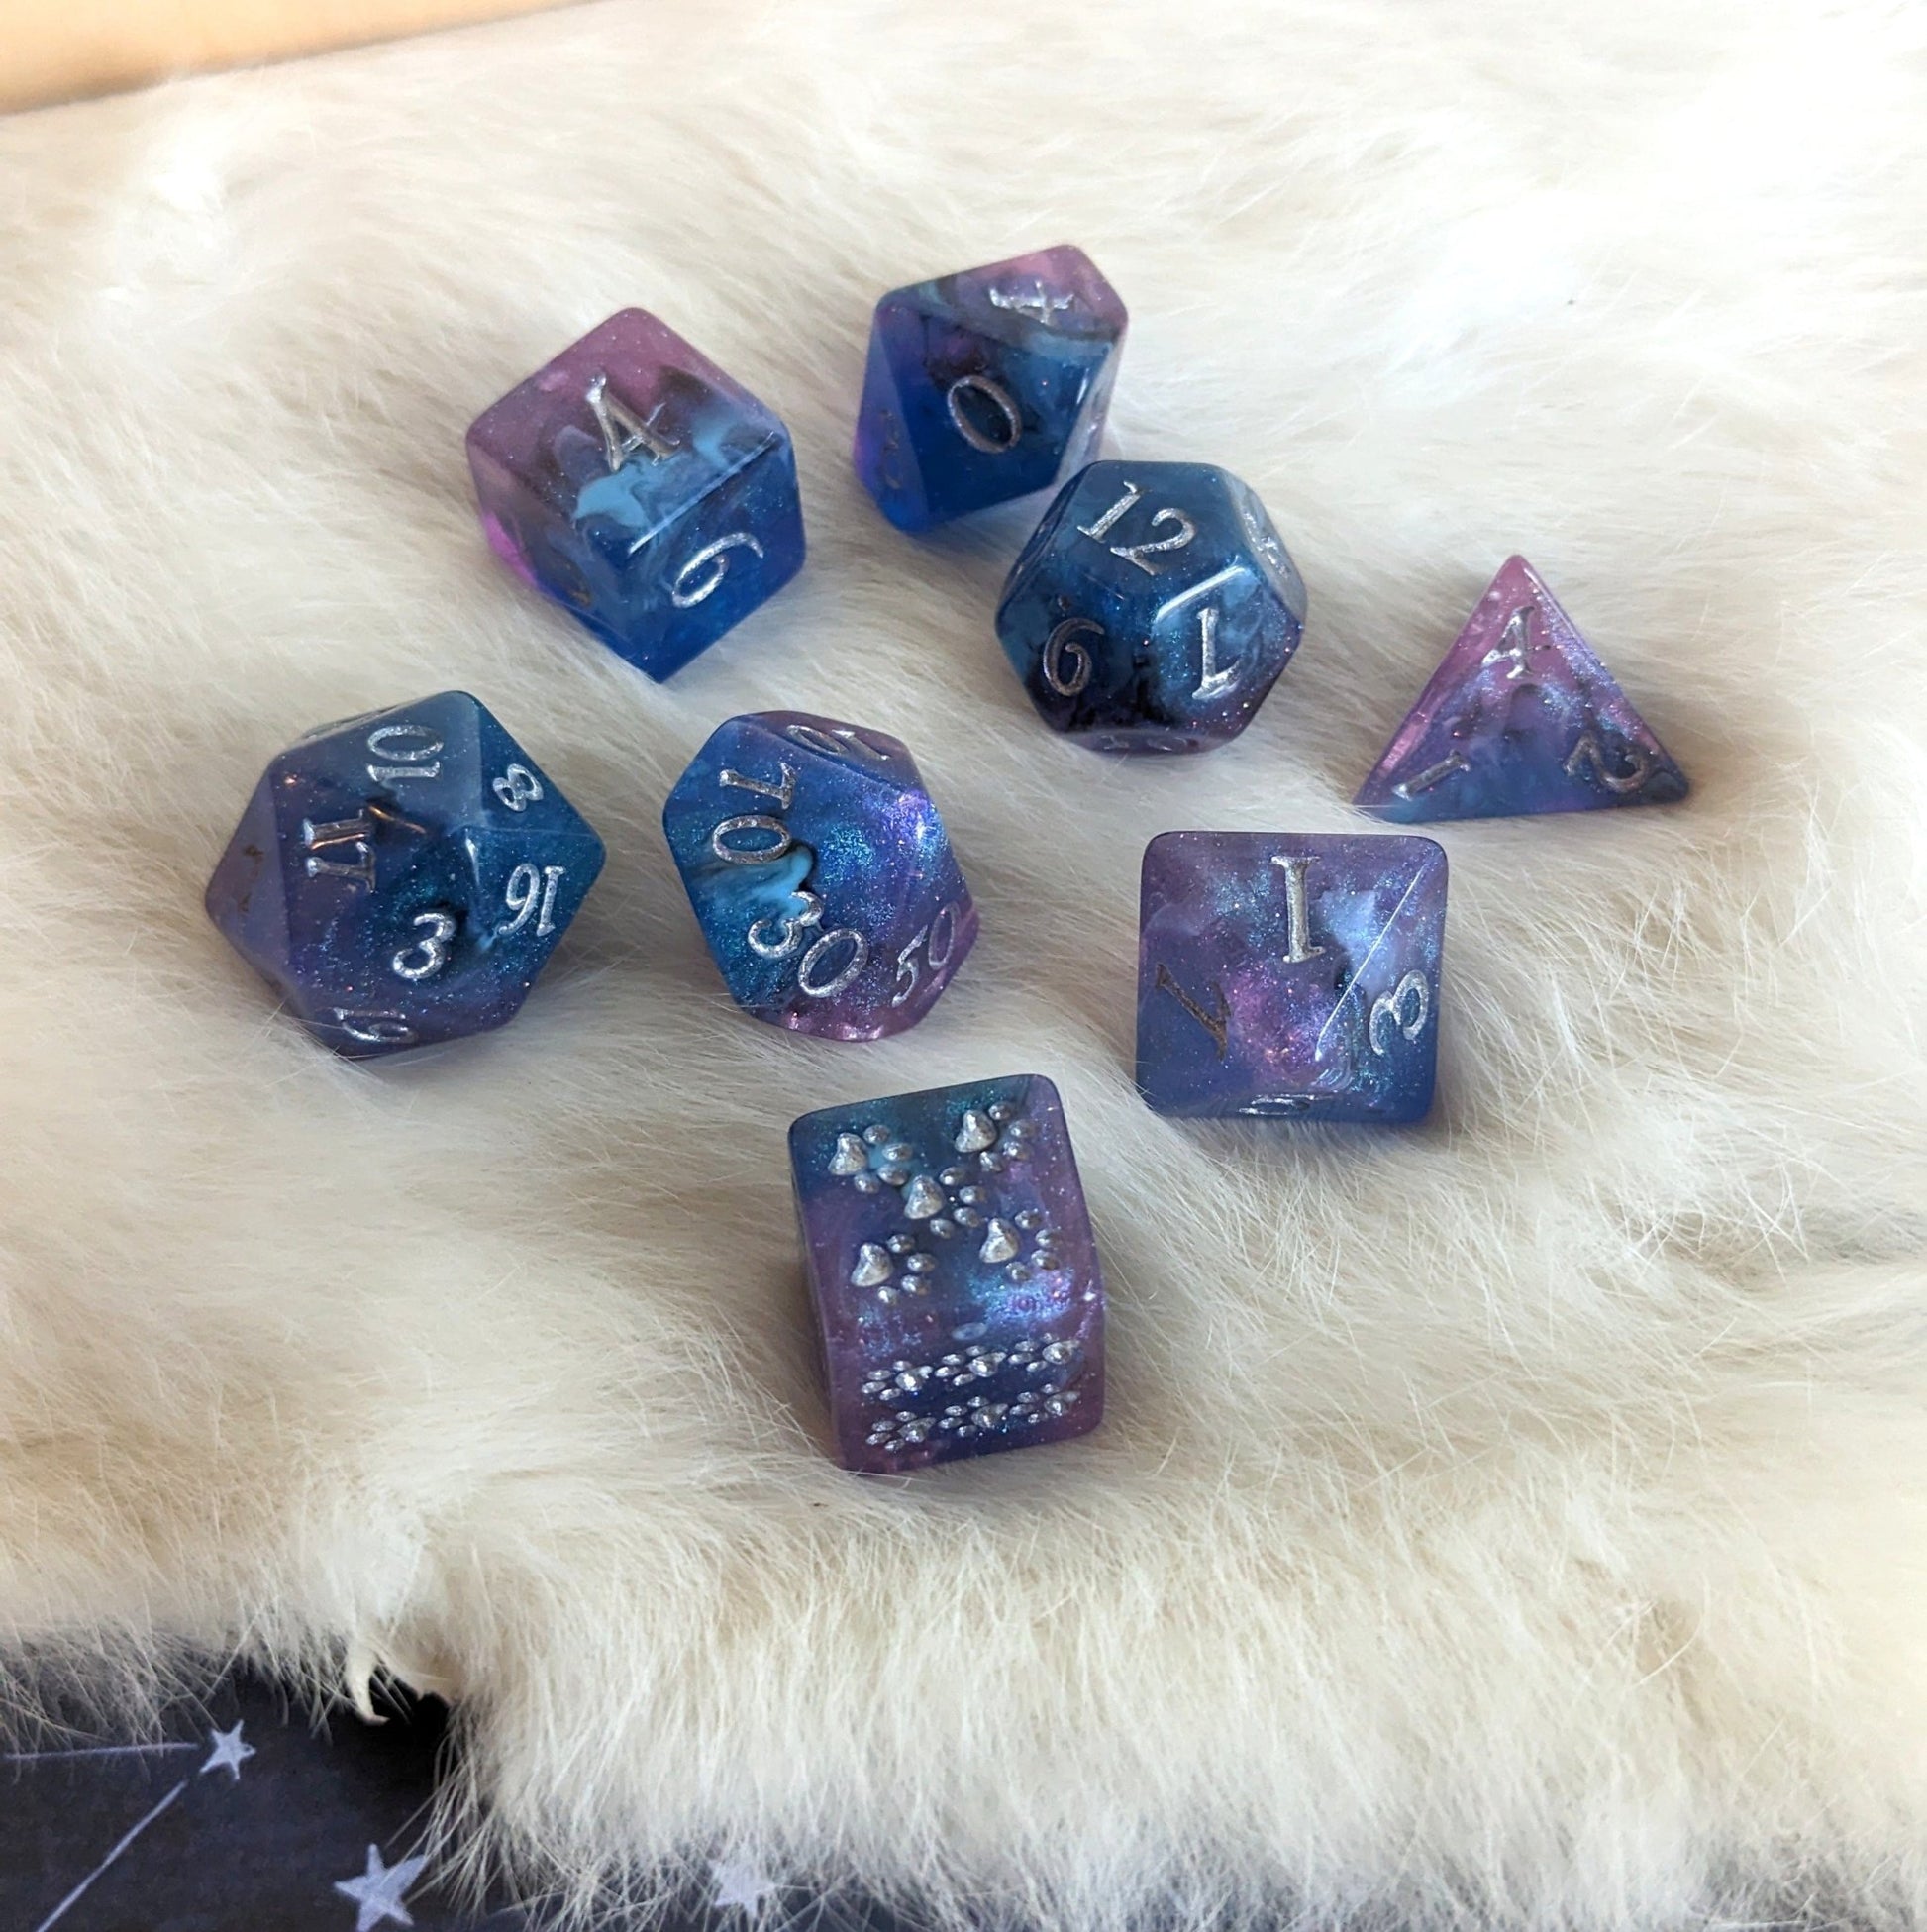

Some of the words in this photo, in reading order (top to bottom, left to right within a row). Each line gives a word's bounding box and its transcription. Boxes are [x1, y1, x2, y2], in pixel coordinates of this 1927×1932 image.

[947, 374, 1022, 455] 0
[1076, 479, 1198, 576] 12
[365, 724, 446, 790] 10
[492, 763, 545, 813] 8
[1390, 749, 1472, 802] 1
[1562, 729, 1651, 793] 2
[712, 762, 797, 864] 70
[392, 911, 456, 980] 3
[747, 890, 868, 998] 30
[891, 901, 961, 1008] 50
[1369, 969, 1430, 1057] 3
